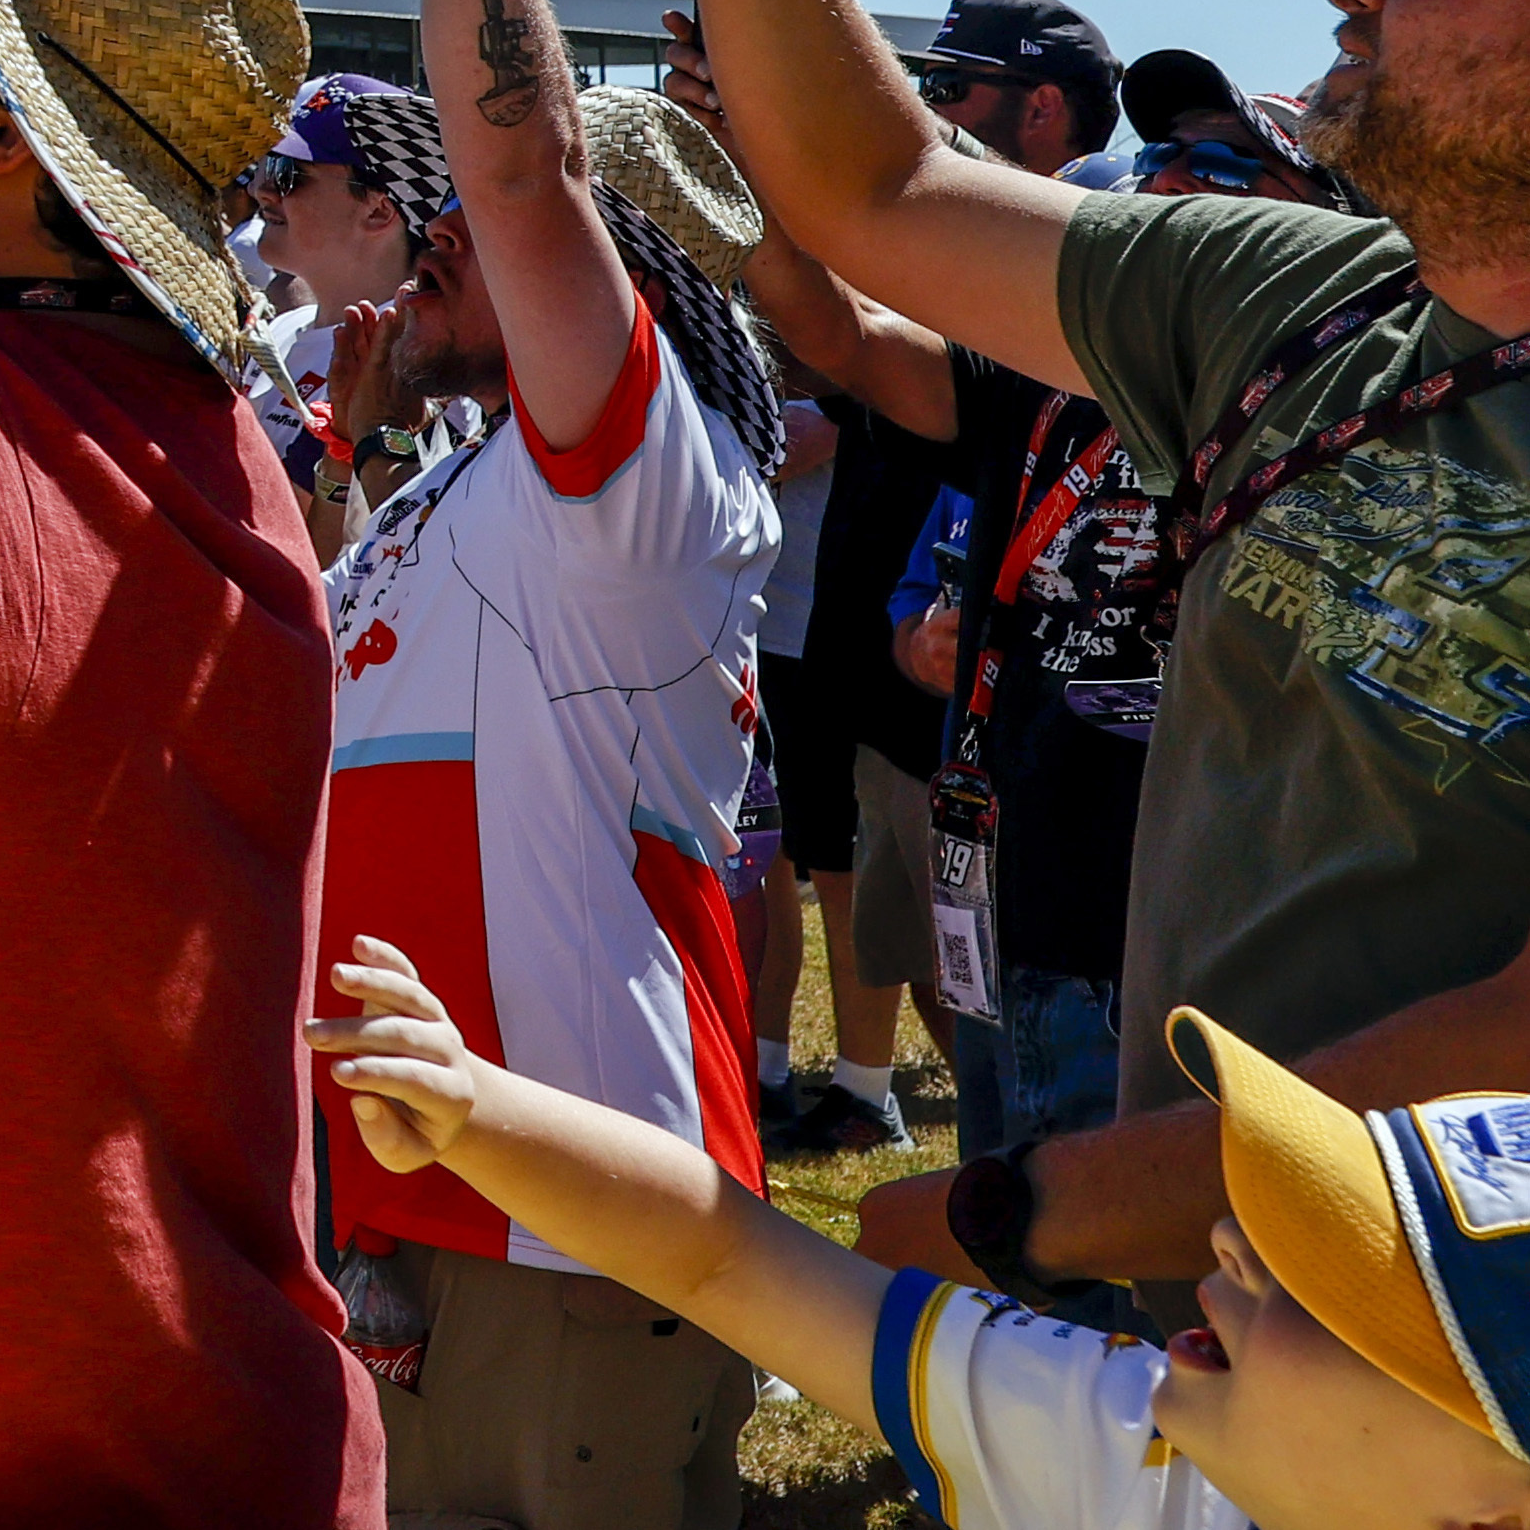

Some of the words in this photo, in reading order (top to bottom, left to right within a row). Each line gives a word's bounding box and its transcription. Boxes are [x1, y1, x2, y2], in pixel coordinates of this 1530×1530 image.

[1061, 463, 1090, 498] 19
[1032, 612, 1054, 640] I
[981, 658, 1000, 689] 19
[1040, 646, 1081, 674] the
[941, 839, 974, 888] 19
